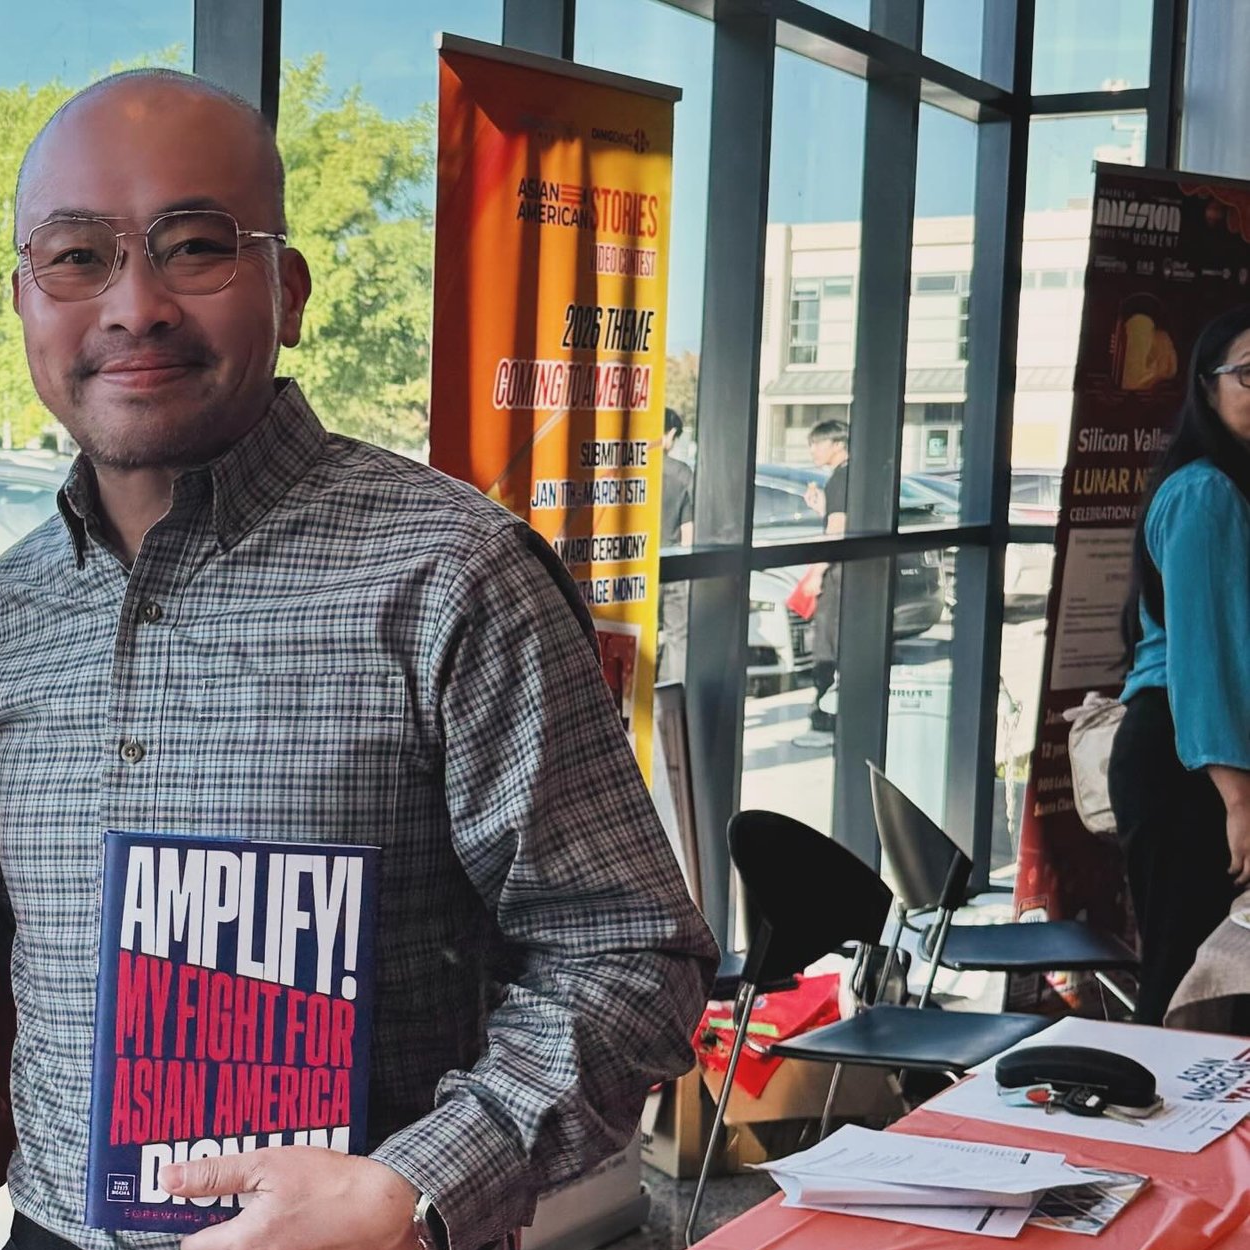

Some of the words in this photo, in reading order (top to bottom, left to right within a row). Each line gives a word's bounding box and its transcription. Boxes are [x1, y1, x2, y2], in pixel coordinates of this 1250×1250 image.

[518, 178, 559, 202] ASIAN
[517, 202, 590, 228] AMERICAN
[591, 186, 658, 238] STORIES
[619, 248, 656, 276] CONTEST
[562, 304, 603, 349] 2026
[605, 307, 654, 352] THEME
[494, 361, 563, 406] COMING
[582, 365, 650, 409] AMERICA
[580, 442, 620, 466] SUBMIT
[622, 441, 647, 466] DATE
[1077, 427, 1129, 453] Silicon
[1134, 427, 1170, 452] Valle
[531, 481, 556, 507] JAN
[584, 480, 620, 505] MARCH
[623, 479, 645, 503] 15TH
[1072, 468, 1130, 495] LUNAR
[1069, 506, 1130, 521] CELEBRATION
[554, 538, 588, 564] AWARD
[591, 535, 647, 561] CEREMONY
[612, 576, 645, 602] MONTH
[120, 846, 363, 1000] AMPLIFY!
[114, 952, 172, 1058] MY
[175, 963, 281, 1064] FIGHT
[283, 990, 356, 1068] FOR
[110, 1057, 206, 1146] ASIAN
[213, 1064, 350, 1137] AMERICA
